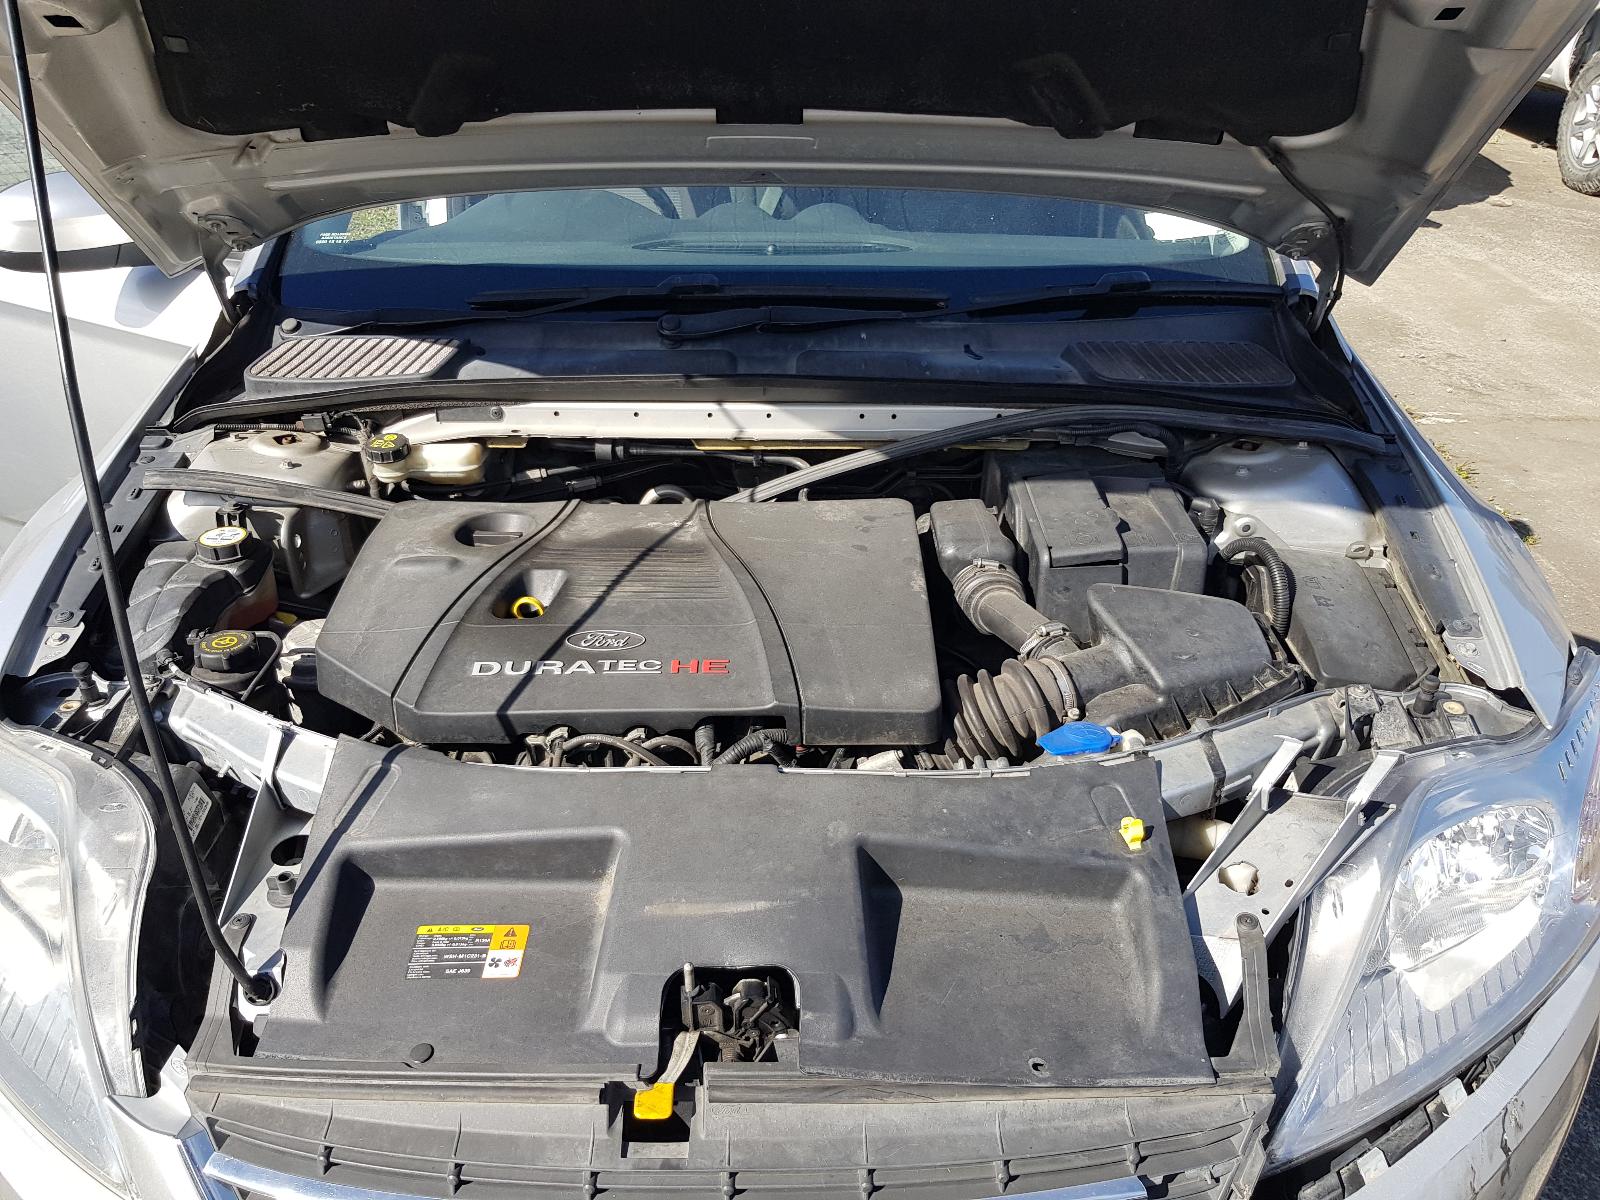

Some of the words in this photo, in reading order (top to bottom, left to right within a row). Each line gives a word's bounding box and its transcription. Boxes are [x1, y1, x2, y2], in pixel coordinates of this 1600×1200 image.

[578, 631, 632, 649] Ford
[471, 659, 662, 676] DURATEC
[670, 659, 730, 674] HE
